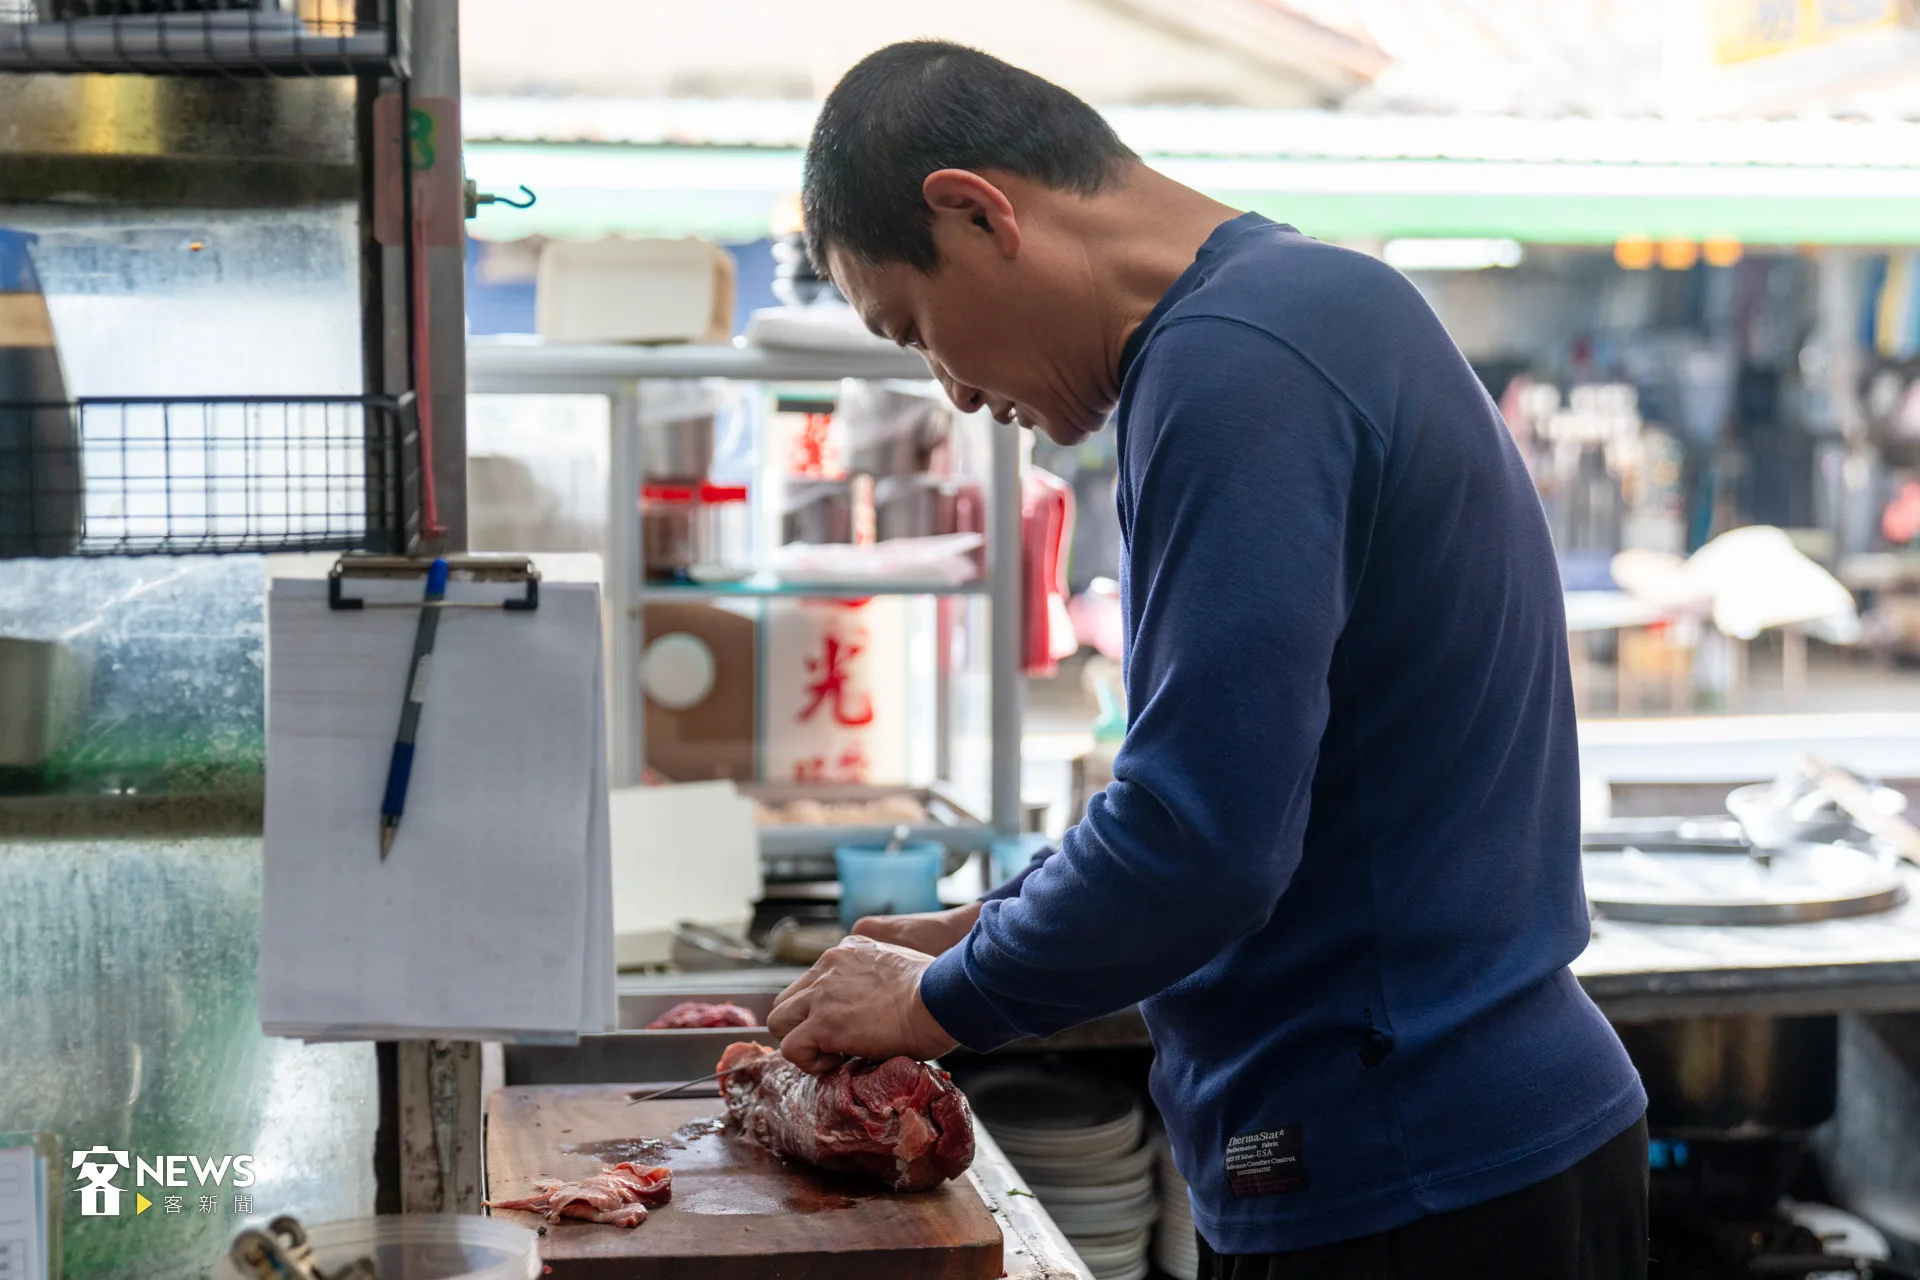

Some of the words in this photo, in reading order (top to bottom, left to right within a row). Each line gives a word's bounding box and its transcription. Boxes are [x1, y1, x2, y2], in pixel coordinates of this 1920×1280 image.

[1261, 1141, 1279, 1149] Fabric
[1246, 1160, 1271, 1168] Comfort
[1270, 1156, 1296, 1165] Control
